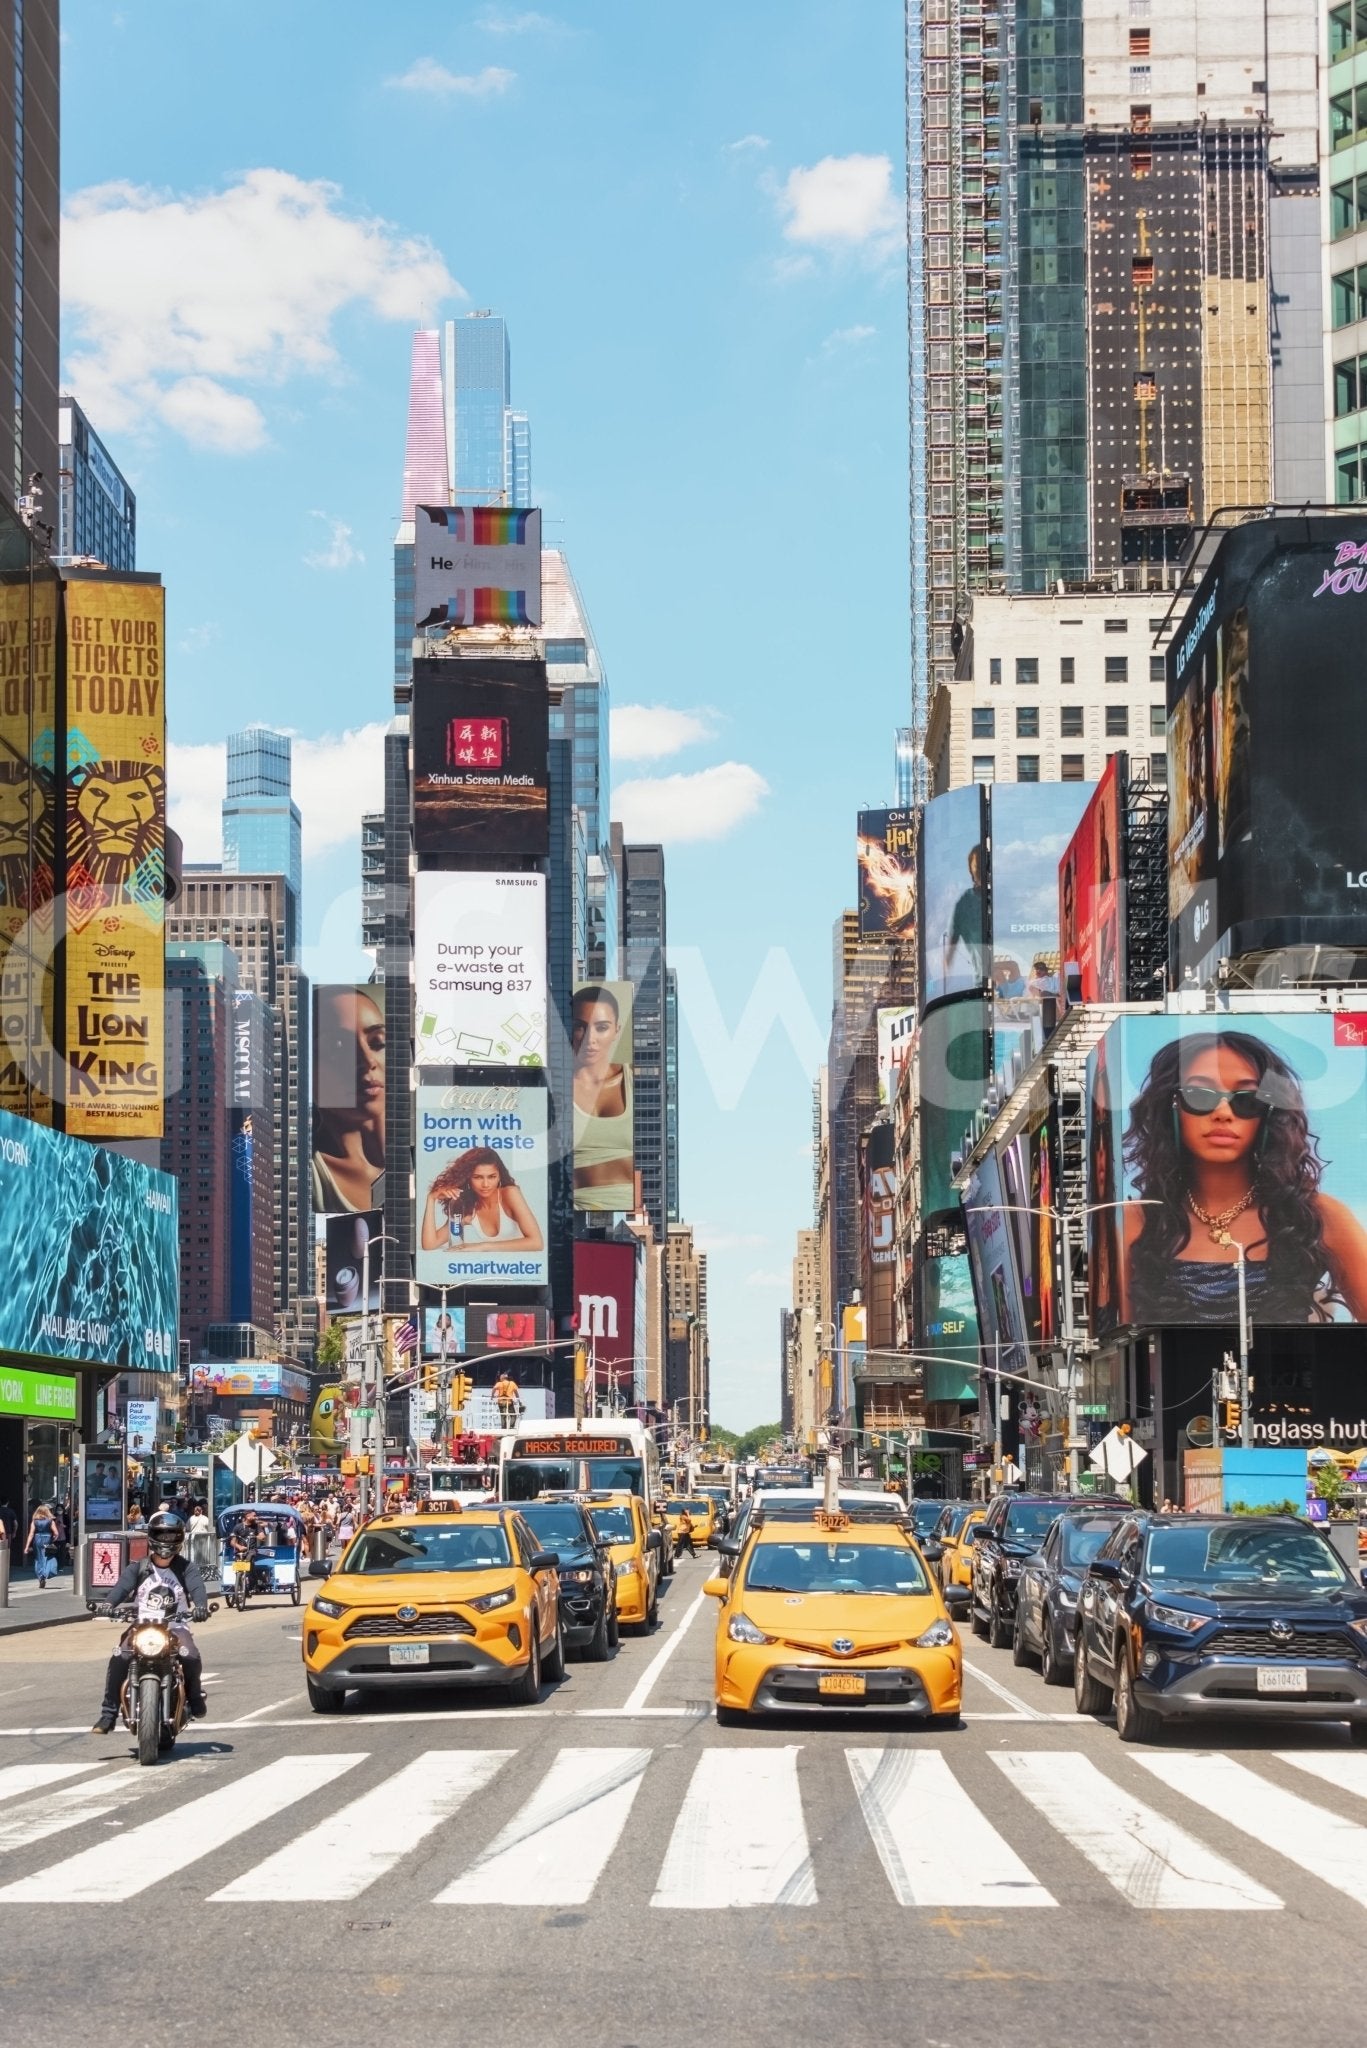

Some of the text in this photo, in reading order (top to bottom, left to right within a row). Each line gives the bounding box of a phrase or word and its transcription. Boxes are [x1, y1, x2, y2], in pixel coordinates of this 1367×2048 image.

[71, 616, 157, 646] GET YOUR
[71, 643, 159, 677] TICKETS
[71, 674, 160, 717] TODAY
[428, 773, 535, 786] Xinhua Screen Media
[888, 812, 906, 821] ON
[495, 878, 538, 887] SAMSUNG
[1010, 923, 1060, 933] EXPRESS
[92, 943, 136, 960] Disney
[437, 943, 523, 960] Dump your
[436, 962, 525, 974] e-waste at
[87, 971, 141, 996] THE
[429, 979, 532, 995] Samsung 837
[69, 1051, 158, 1097] KING
[70, 1102, 159, 1112] THE AWARD-WINNING
[86, 1110, 143, 1120] BEST MUSICAL
[424, 1112, 522, 1130] born with
[423, 1134, 535, 1152] great taste
[447, 1260, 543, 1275] smartwater
[578, 1294, 619, 1338] m
[41, 1313, 111, 1346] AVAILABLE NOW
[1, 1379, 24, 1404] YORK
[35, 1383, 53, 1406] LINE
[1091, 1406, 1100, 1414] 45
[1225, 1417, 1367, 1446] snglass hut
[525, 1440, 617, 1453] MASKS REQUIRED
[428, 1501, 448, 1512] 3C17
